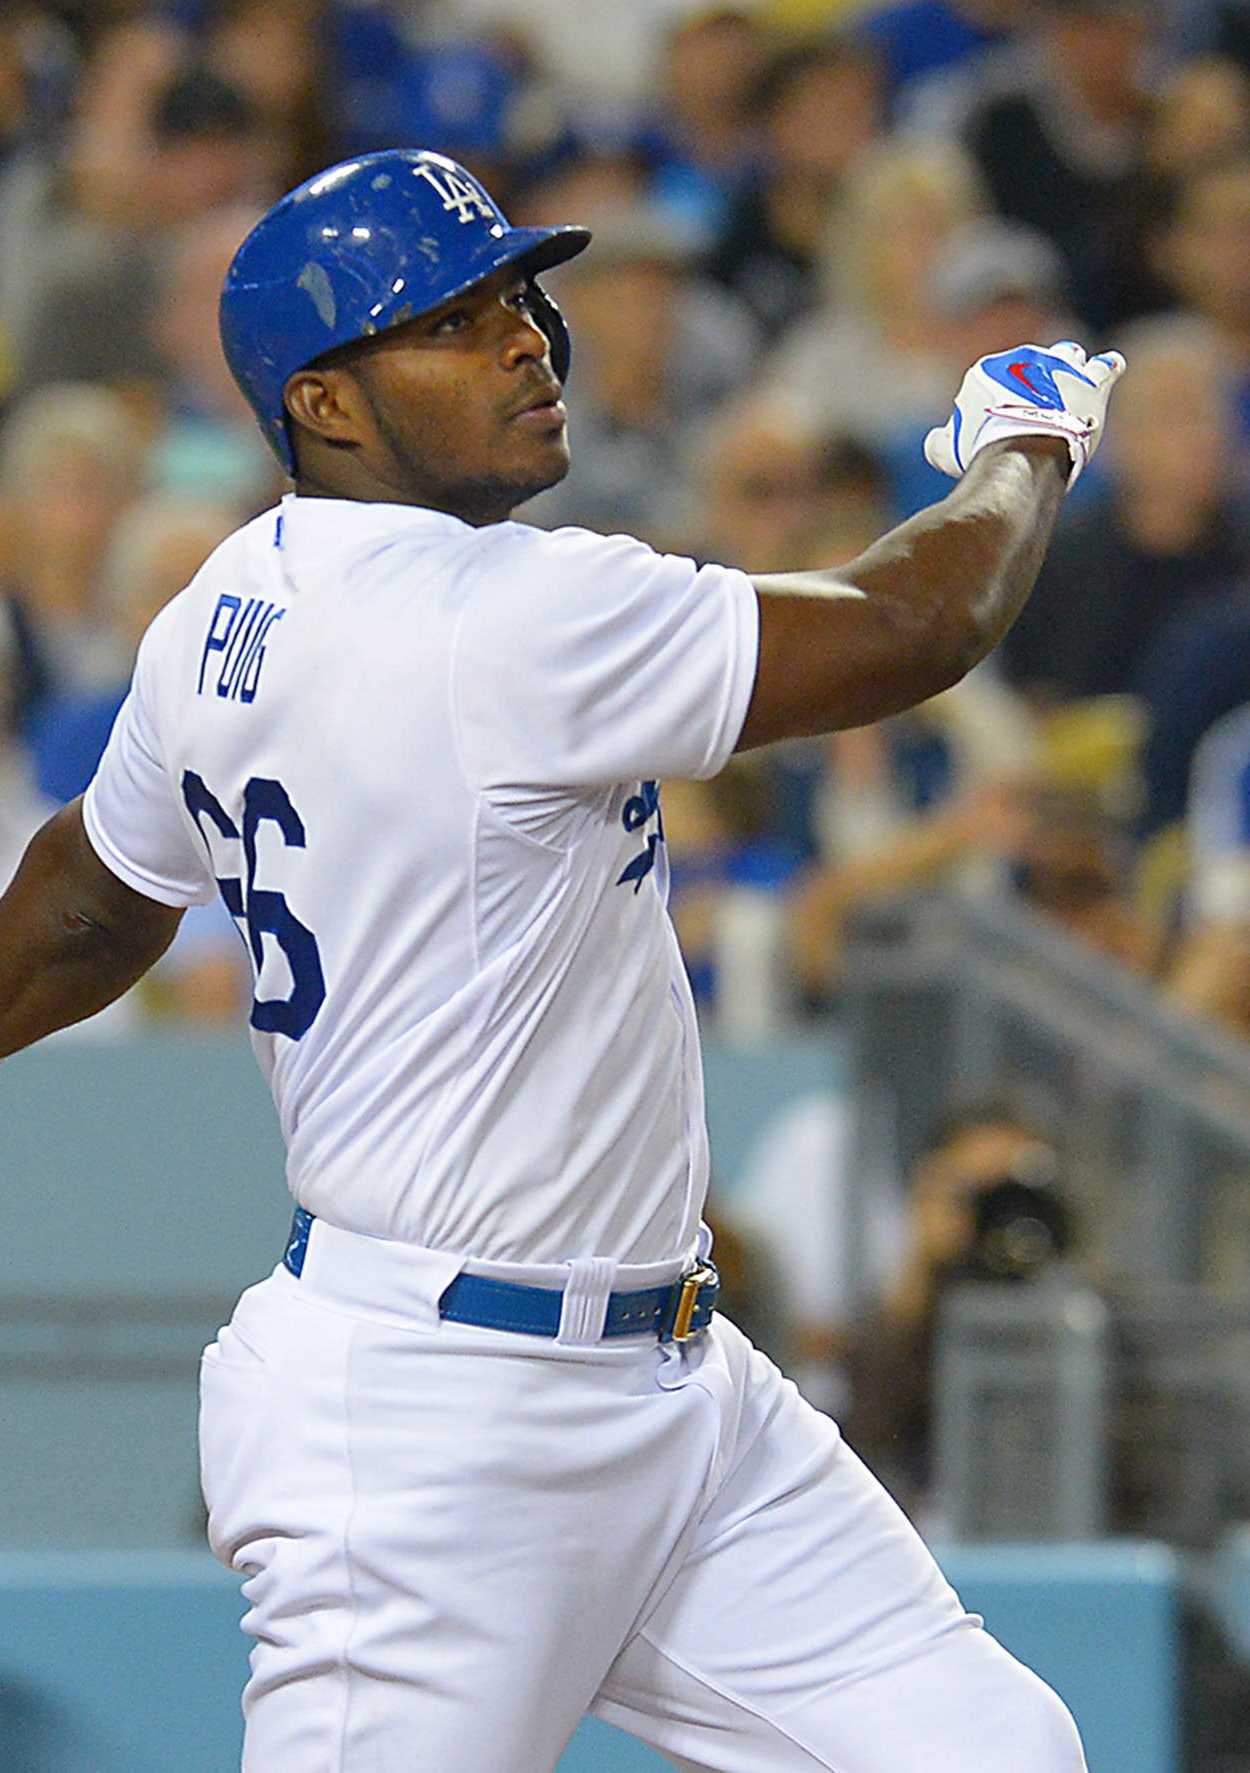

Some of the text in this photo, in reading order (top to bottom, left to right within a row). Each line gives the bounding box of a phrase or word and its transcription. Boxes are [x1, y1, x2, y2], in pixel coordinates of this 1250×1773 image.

[412, 164, 495, 224] LA
[197, 593, 286, 704] PUIG
[181, 769, 326, 1041] 66
